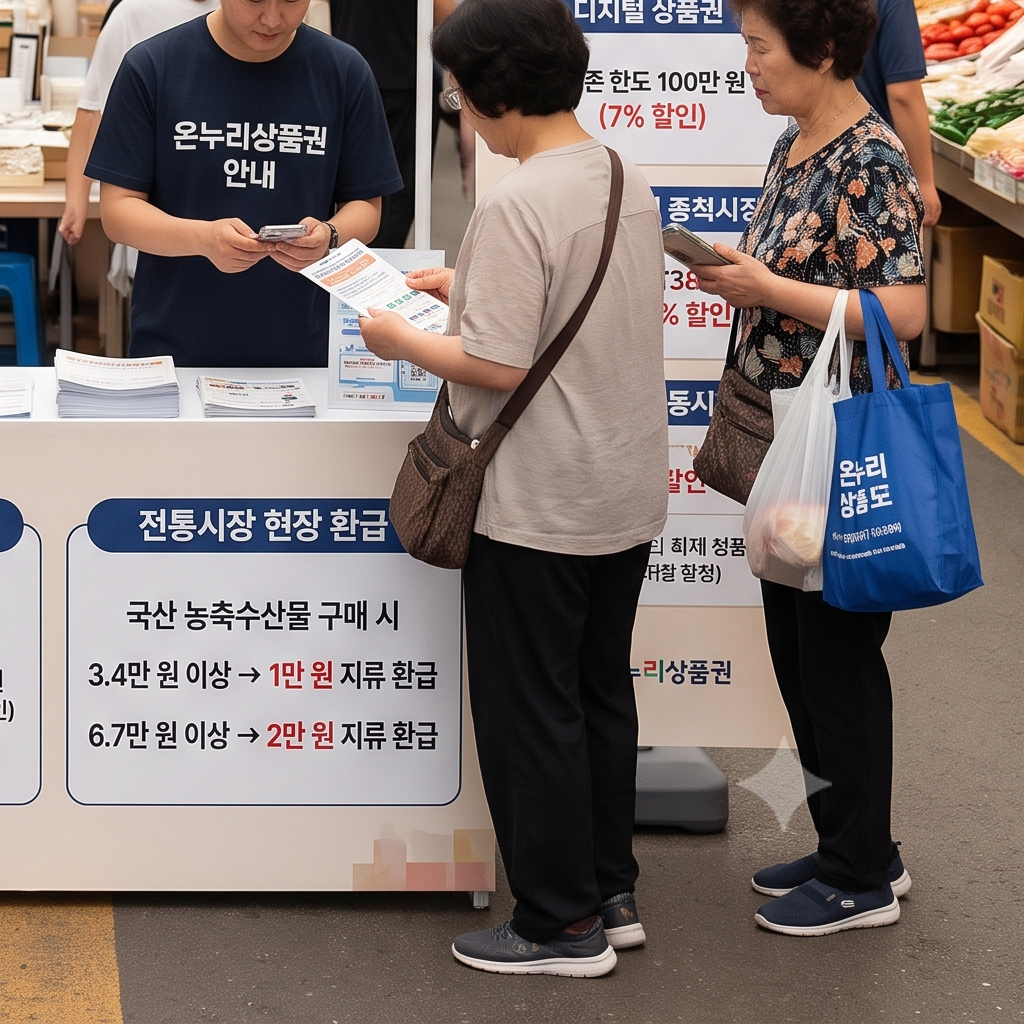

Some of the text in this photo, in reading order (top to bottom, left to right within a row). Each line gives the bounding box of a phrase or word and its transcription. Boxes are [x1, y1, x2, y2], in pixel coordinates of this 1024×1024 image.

[609, 69, 652, 95] 한도
[657, 69, 721, 95] 100만
[724, 70, 746, 95] 원
[598, 102, 707, 131] (7% 할인)
[172, 120, 328, 156] 온누리상품권
[222, 158, 276, 190] 안내
[685, 301, 732, 328] 할인
[667, 389, 718, 418] 동시
[138, 507, 390, 544] 전통시장 현장 환급
[126, 599, 400, 631] 국산 농축수산물 구매 시
[87, 661, 439, 690] 3.4만 원 이상 1만 원 지류 환급
[88, 721, 439, 750] 6.7만 원 이상 2만 원 지류 환급
